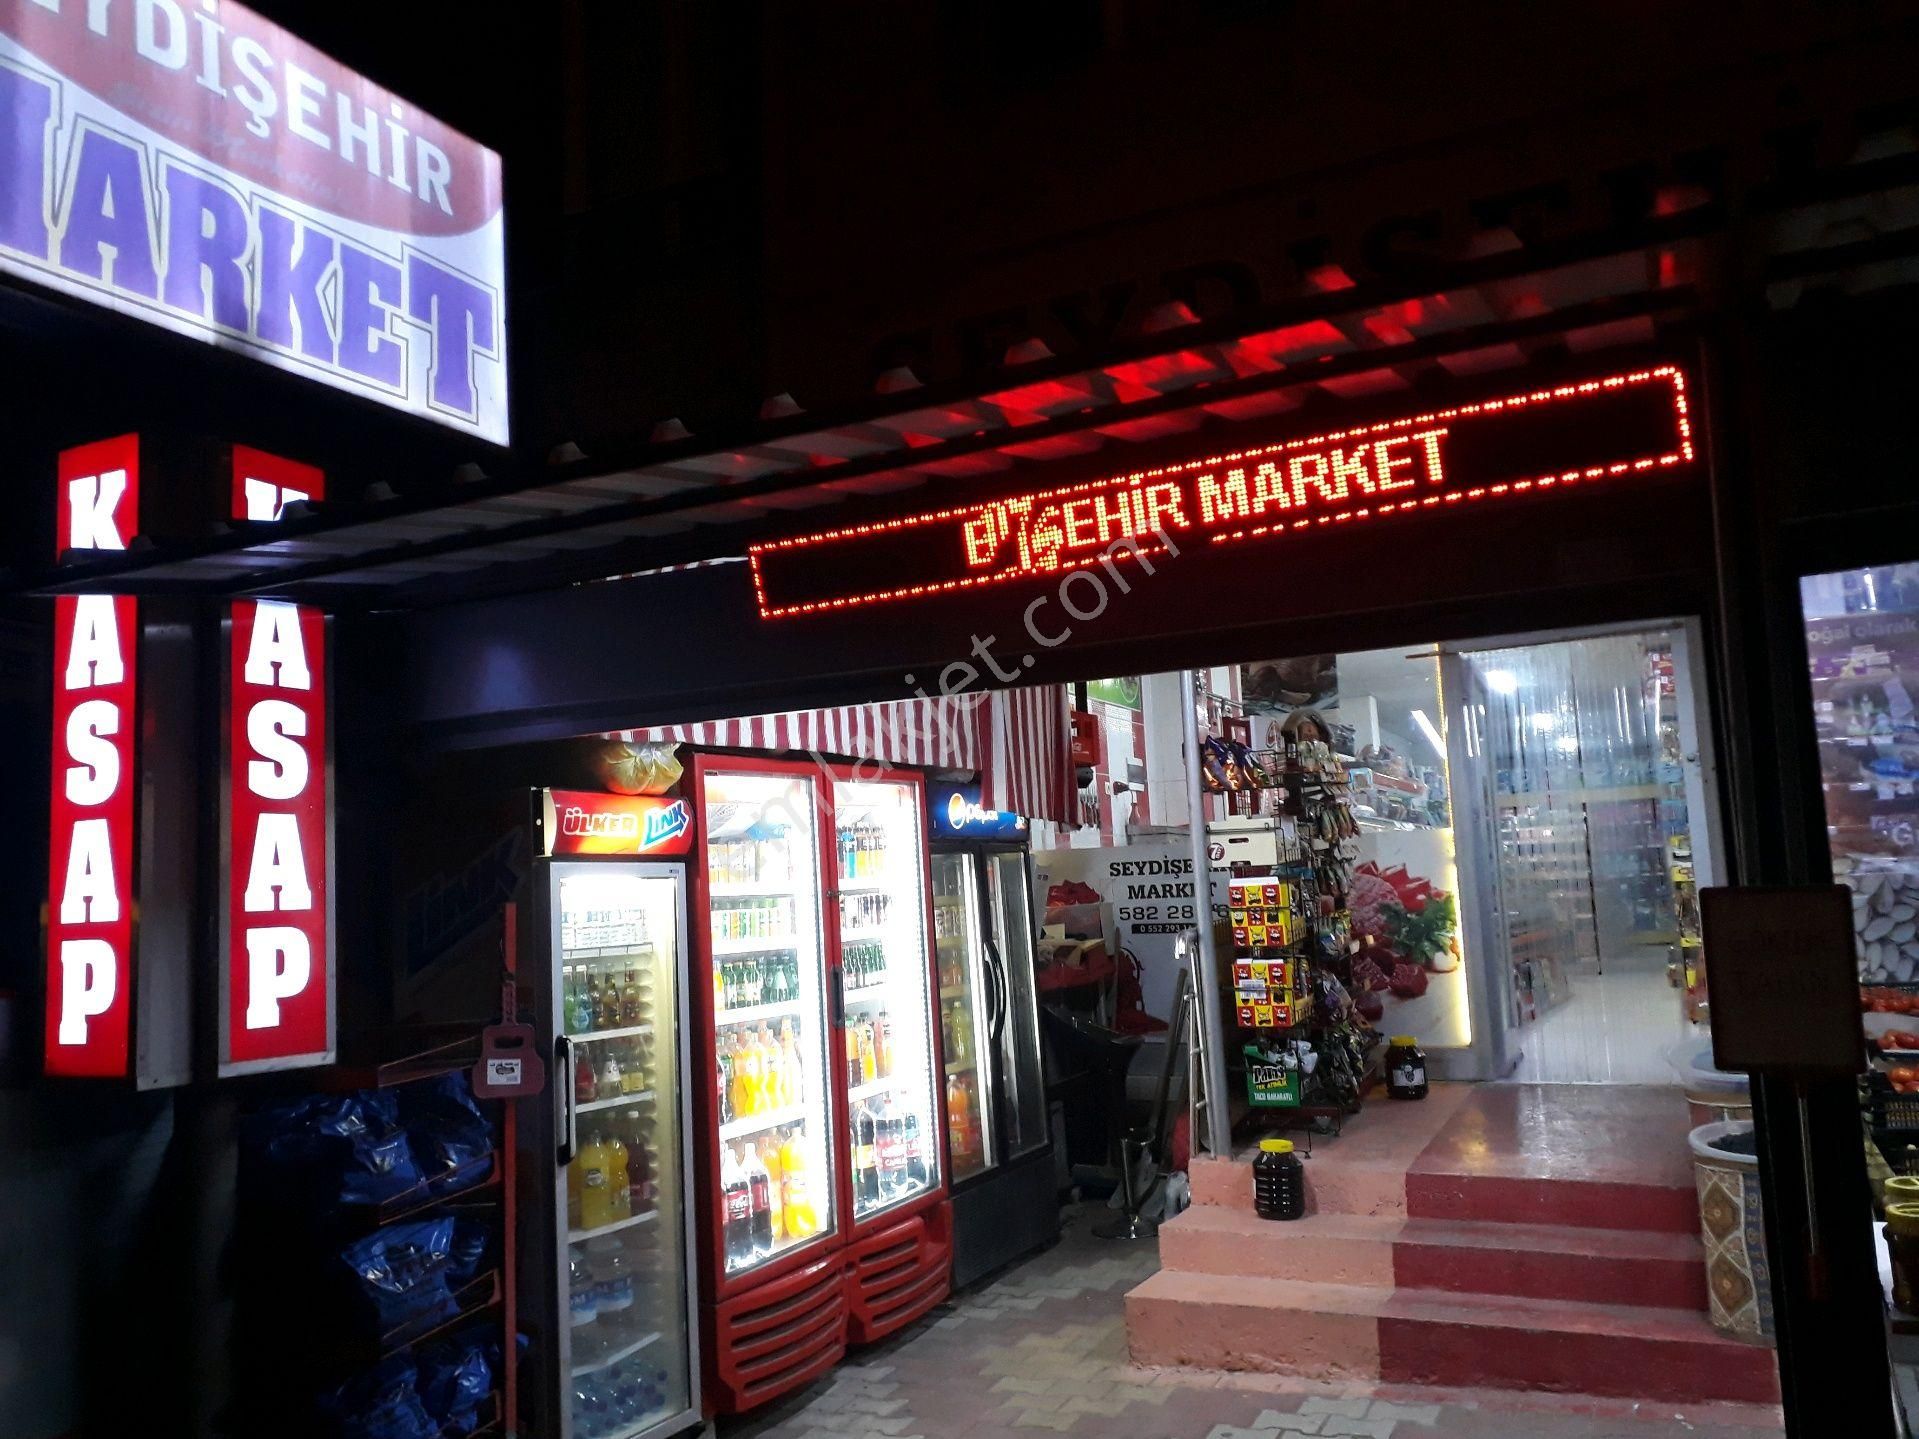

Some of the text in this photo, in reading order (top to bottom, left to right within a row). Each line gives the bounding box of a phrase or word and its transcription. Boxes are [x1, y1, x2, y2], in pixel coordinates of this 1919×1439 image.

[32, 0, 453, 216] DİŞEHİR
[1198, 428, 1449, 522] MARKET
[1807, 622, 1851, 644] oğal
[59, 470, 126, 1045] KASAP
[563, 807, 638, 837] ÜLKER
[1110, 855, 1229, 878] SEYDİŞE
[1120, 906, 1158, 921] 582
[1167, 905, 1194, 920] 28
[1140, 925, 1146, 933] 0
[1148, 925, 1162, 933] 552
